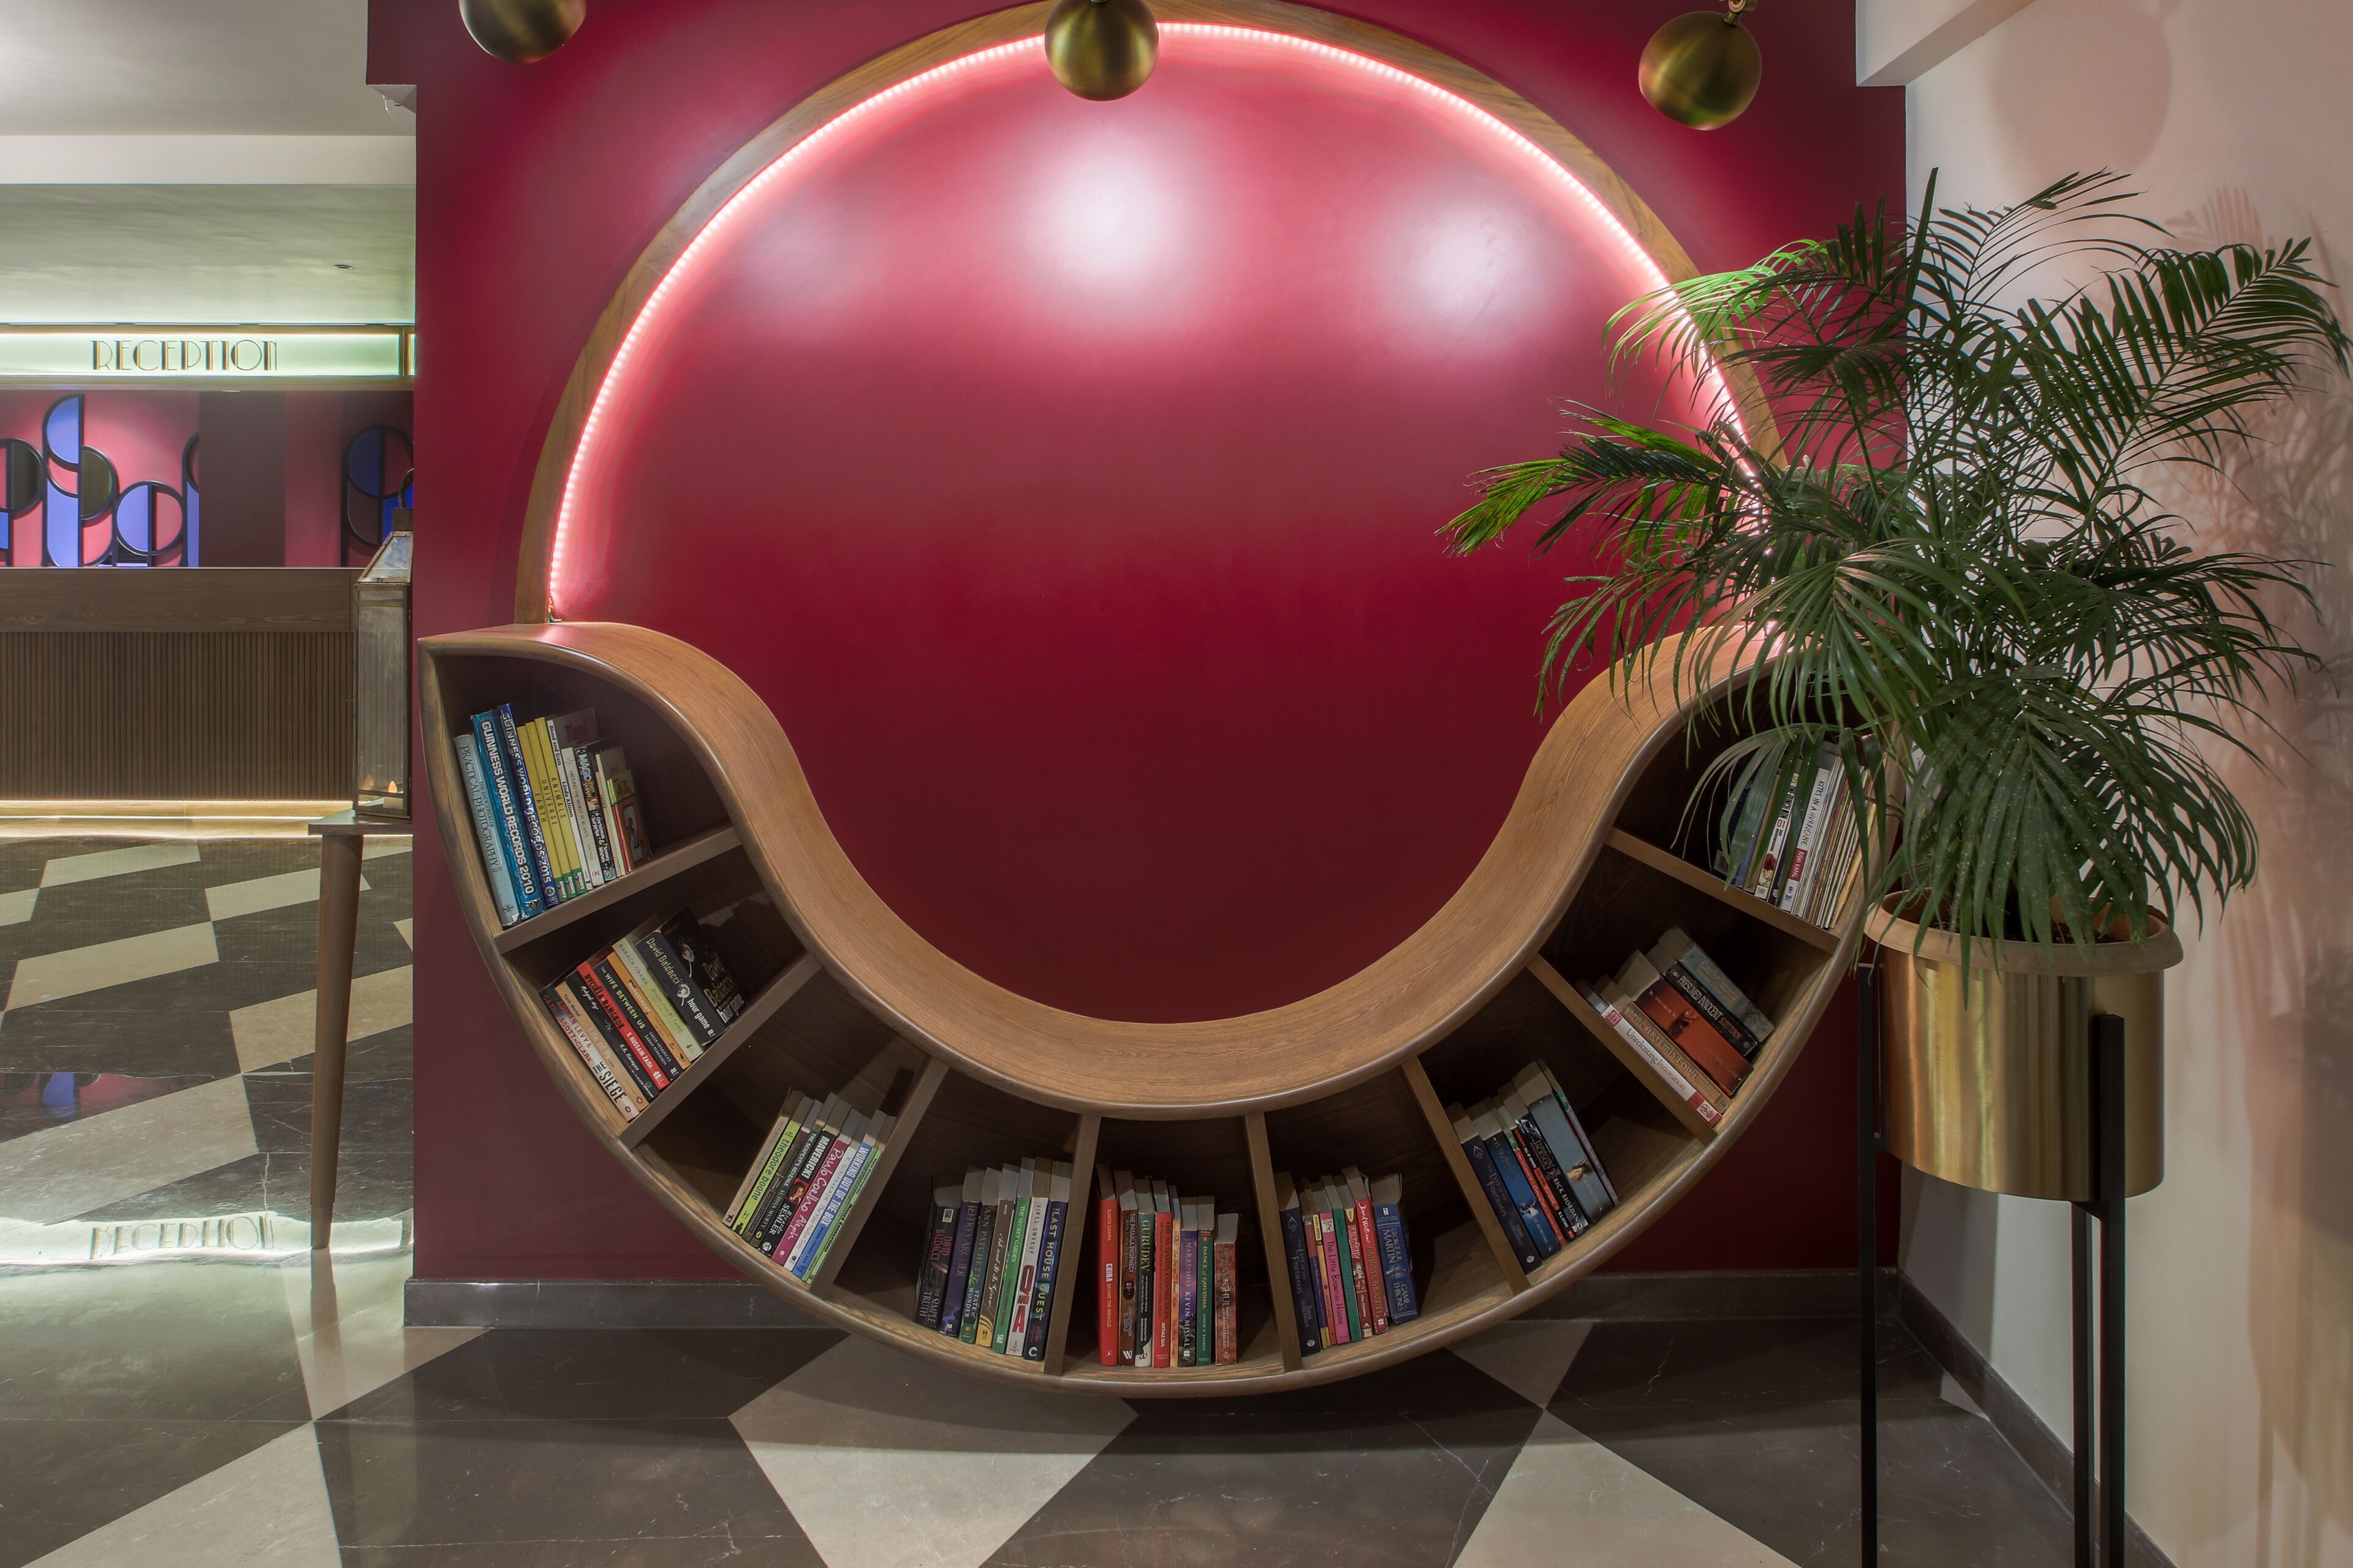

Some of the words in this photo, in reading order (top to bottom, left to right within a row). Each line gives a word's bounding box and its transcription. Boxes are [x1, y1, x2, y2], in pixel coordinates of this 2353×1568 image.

[91, 339, 277, 371] RECEPTION
[547, 724, 557, 741] Blood
[553, 752, 563, 767] Guts
[501, 711, 523, 767] GUINNESS
[514, 767, 533, 807] WORLD
[524, 806, 546, 858] RECORDS
[537, 858, 552, 884] 2015
[550, 776, 567, 819] ANIMALS
[560, 780, 570, 797] Linda
[567, 769, 578, 790] AROUND
[574, 798, 584, 814] WORLD
[1811, 797, 1820, 806] IN
[1813, 779, 1825, 797] KITES
[459, 744, 480, 797] PRACTICAL
[472, 795, 499, 868] PHOTOGRAPHY
[480, 720, 504, 776] GUINNESS
[495, 775, 514, 816] WORLD
[505, 814, 527, 865] RECORDS
[518, 865, 535, 895] 2010
[534, 792, 548, 824] EARTH
[540, 779, 558, 827] UNIVERSE
[564, 797, 575, 818] Allison
[589, 816, 601, 838] Surprise
[594, 816, 605, 840] Christmas
[1799, 811, 1817, 847] HURRICANE
[601, 845, 611, 862] Snowy
[1790, 862, 1802, 879] KAPAL
[645, 936, 665, 958] David
[617, 942, 636, 967] BARACK
[632, 964, 649, 986] OBAMA
[657, 953, 683, 985] Baldacci
[562, 993, 573, 1005] Yann
[569, 1002, 582, 1018] Martel
[604, 972, 618, 990] WIFE
[615, 989, 639, 1020] BETWEEN
[635, 1018, 646, 1029] US
[686, 996, 702, 1015] hour
[1653, 994, 1673, 1014] ROWLING
[1675, 974, 1703, 1002] PRESUMED
[1696, 994, 1724, 1022] INNOCENT
[1718, 1015, 1732, 1030] SCOTT
[555, 999, 577, 1026] ADRIAN
[573, 1024, 589, 1043] LEVY
[693, 1011, 711, 1031] game
[557, 1016, 594, 1064] SCOTT-CLARK
[586, 1026, 601, 1042] Life
[596, 1040, 607, 1051] of
[602, 1048, 613, 1059] Pi
[624, 1031, 634, 1039] S.
[628, 1036, 646, 1057] HUSSAIN
[618, 1042, 629, 1054] R.K.
[624, 1051, 640, 1072] Narayan
[640, 1054, 654, 1069] ZAIDI
[1622, 1028, 1661, 1066] Unrelenting
[1654, 1058, 1689, 1091] Innovation
[1642, 1023, 1680, 1060] ARTEMIS
[1674, 1056, 1701, 1082] FOWL
[592, 1060, 607, 1075] THE
[597, 1069, 627, 1104] SIEGE
[807, 1131, 817, 1143] THE
[764, 1137, 790, 1176] theodore
[800, 1134, 830, 1180] MAVERICK!
[819, 1145, 844, 1179] Paulo
[845, 1145, 870, 1178] WORKING
[750, 1175, 770, 1202] boone
[782, 1165, 798, 1188] REVENGE
[838, 1175, 853, 1192] OUT
[1531, 1135, 1555, 1172] JACKSON
[1552, 1176, 1565, 1194] RICK
[1560, 1192, 1580, 1223] RIORDAN
[770, 1188, 786, 1210] SUDHA
[799, 1175, 827, 1214] Coelho
[826, 1197, 841, 1214] THE
[833, 1189, 846, 1200] OF
[1485, 1180, 1510, 1218] FIREDRAKES
[759, 1208, 775, 1230] MURTY
[768, 1202, 790, 1236] SEMLER
[775, 1210, 793, 1235] Ricardo
[819, 1211, 833, 1227] BOX
[839, 1202, 853, 1222] Missed
[981, 1207, 991, 1228] ANN
[1033, 1204, 1042, 1224] VIKAS
[1048, 1210, 1059, 1238] LAST
[782, 1211, 807, 1243] Aleph
[822, 1221, 843, 1253] Connections
[1014, 1217, 1023, 1239] SECRET
[1390, 1227, 1401, 1251] GEORGE
[1535, 1222, 1549, 1245] ROWLING
[930, 1228, 944, 1261] BALDACCI
[940, 1235, 952, 1256] DAVID
[974, 1230, 987, 1279] PATCHETT
[1010, 1239, 1020, 1263] GARDEN
[1028, 1227, 1037, 1255] SWARUP
[1140, 1219, 1150, 1271] GURUDEV
[1164, 1237, 1170, 1246] AL
[1325, 1240, 1336, 1253] The
[1381, 1227, 1398, 1264] MARTIN
[1040, 1241, 1055, 1279] HOUSE
[1326, 1253, 1340, 1273] Little
[1328, 1273, 1344, 1302] Brownie
[1355, 1279, 1366, 1290] 42
[1392, 1281, 1405, 1311] THRONES
[1399, 1283, 1410, 1305] GAME
[919, 1290, 931, 1317] TRUTH
[926, 1297, 940, 1324] SIMPLE
[964, 1286, 974, 1318] WONDER
[971, 1289, 980, 1311] STATE
[1034, 1283, 1048, 1321] GUEST
[1333, 1302, 1347, 1325] House
